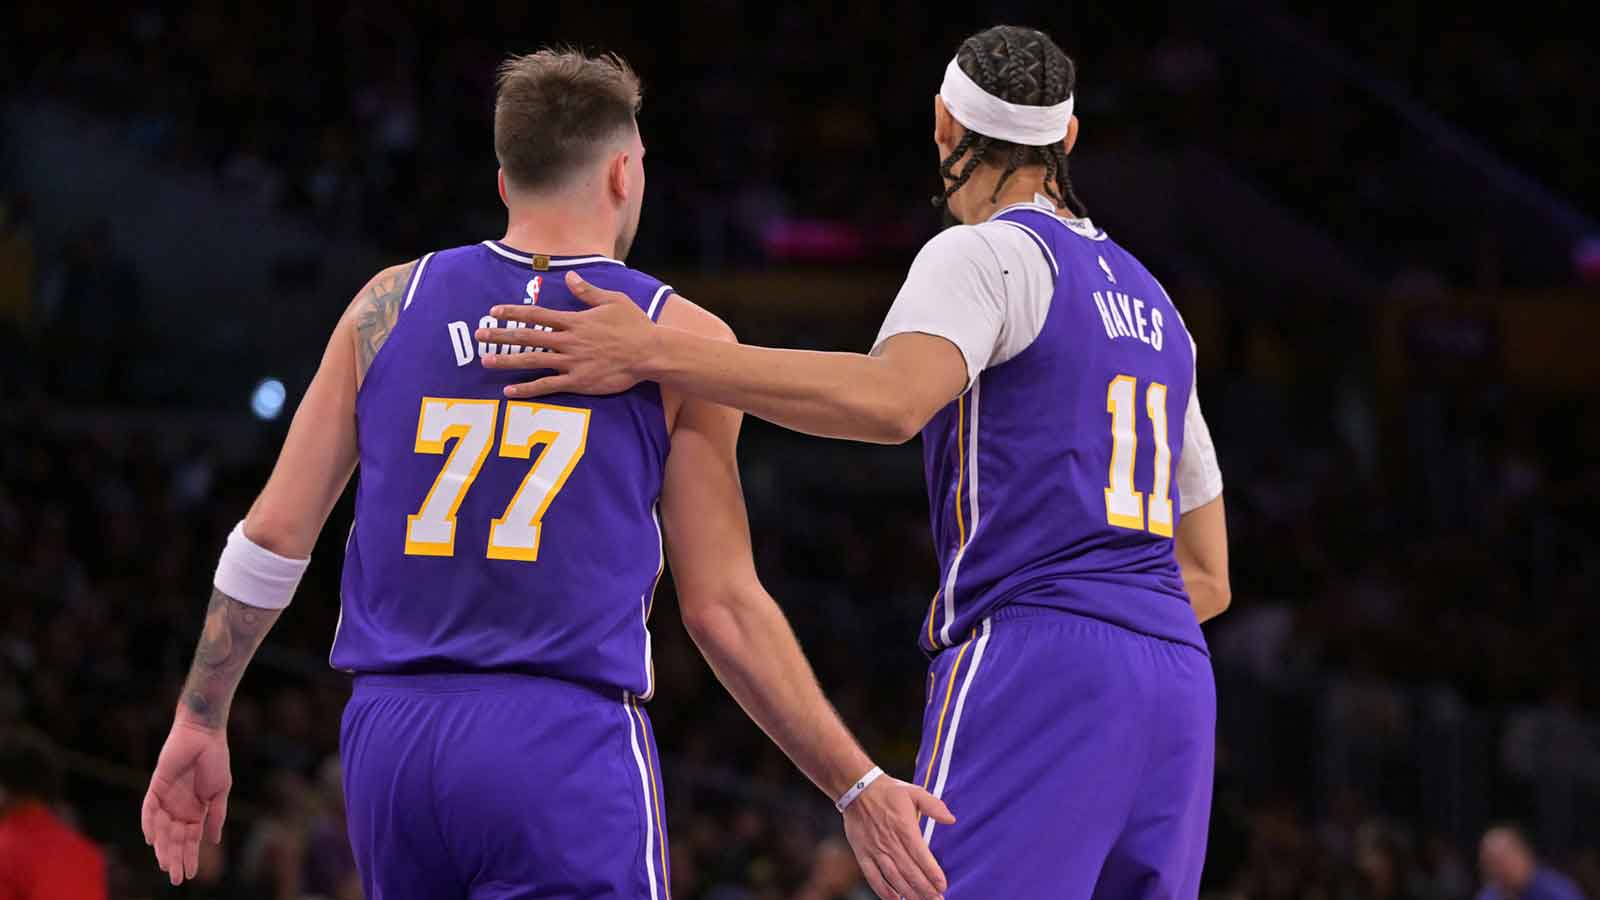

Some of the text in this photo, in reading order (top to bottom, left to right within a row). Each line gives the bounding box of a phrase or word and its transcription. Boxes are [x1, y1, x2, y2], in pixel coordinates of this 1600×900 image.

[1093, 290, 1163, 352] HAYES
[404, 397, 592, 562] 77
[1104, 374, 1173, 538] 11
